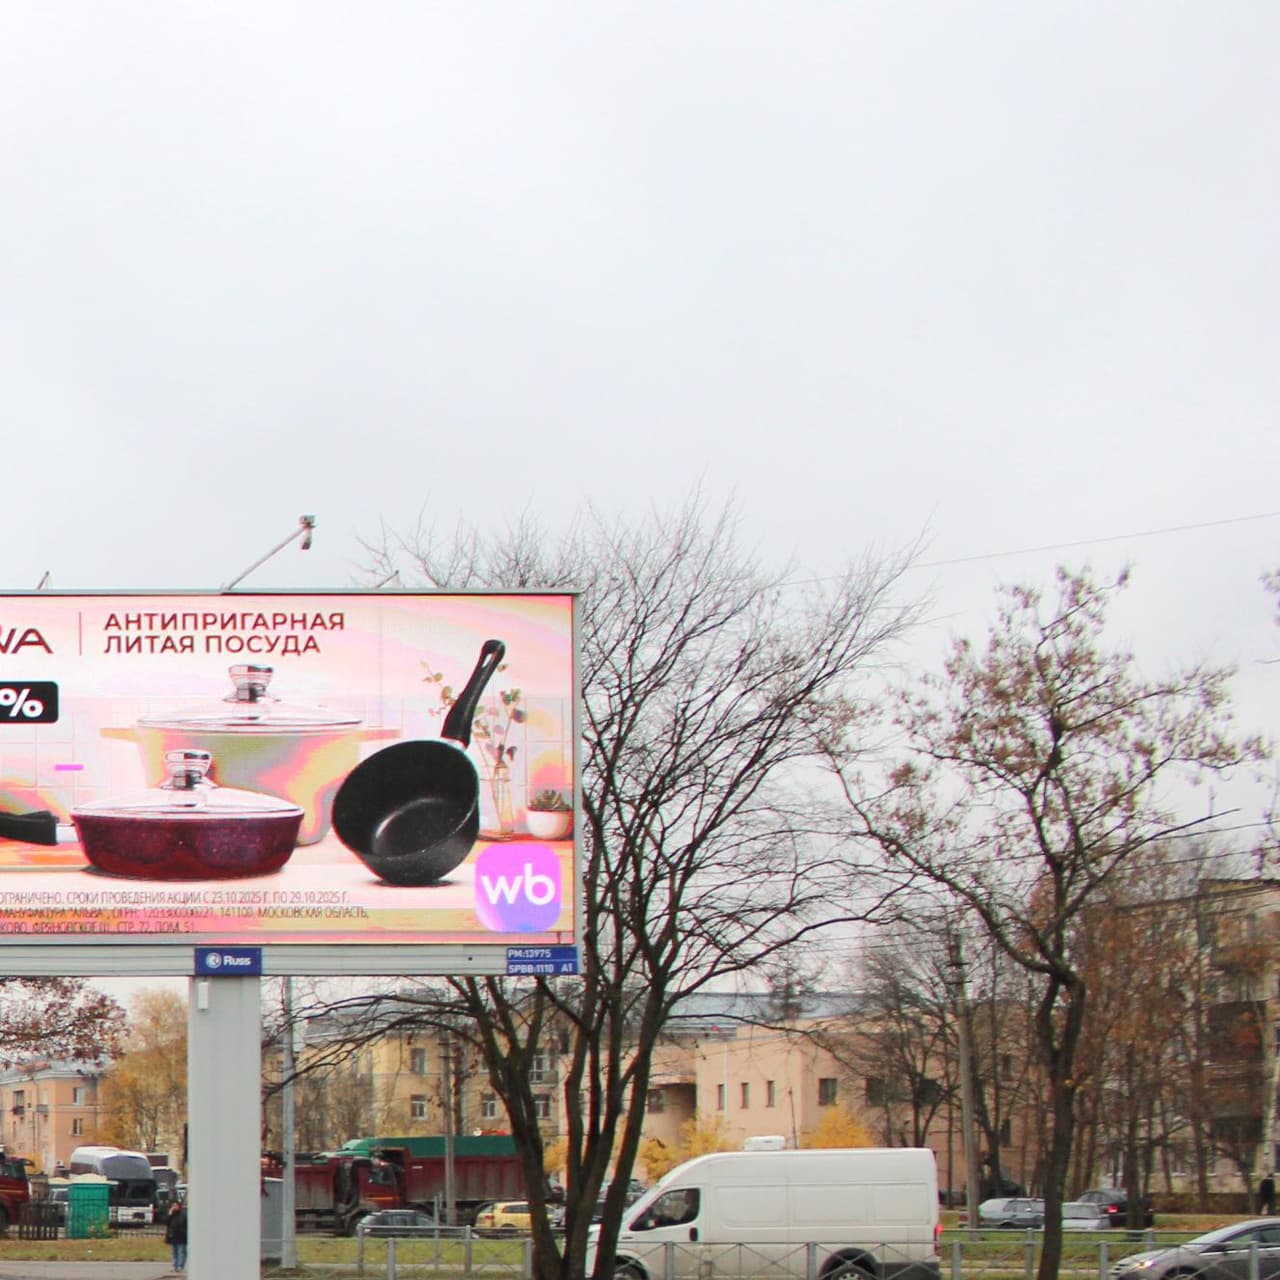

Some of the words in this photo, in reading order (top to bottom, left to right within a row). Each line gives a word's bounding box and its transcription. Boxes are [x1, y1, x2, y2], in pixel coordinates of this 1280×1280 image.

[103, 613, 345, 631] АНТИПРИГАРНАЯ
[103, 635, 195, 654] ЛИТАЯ
[206, 635, 321, 657] ПОСУДА
[480, 863, 556, 906] wb
[66, 891, 99, 905] СРОКИ
[101, 891, 165, 905] ПРОВЕДЕНИЯ
[167, 891, 201, 905] АКЦИИ
[211, 891, 262, 904] 23.10.2025
[272, 891, 288, 904] ПО
[289, 891, 341, 904] 29.10.2025
[257, 906, 322, 918] МОСКОВСКАЯ
[223, 955, 251, 966] Russ
